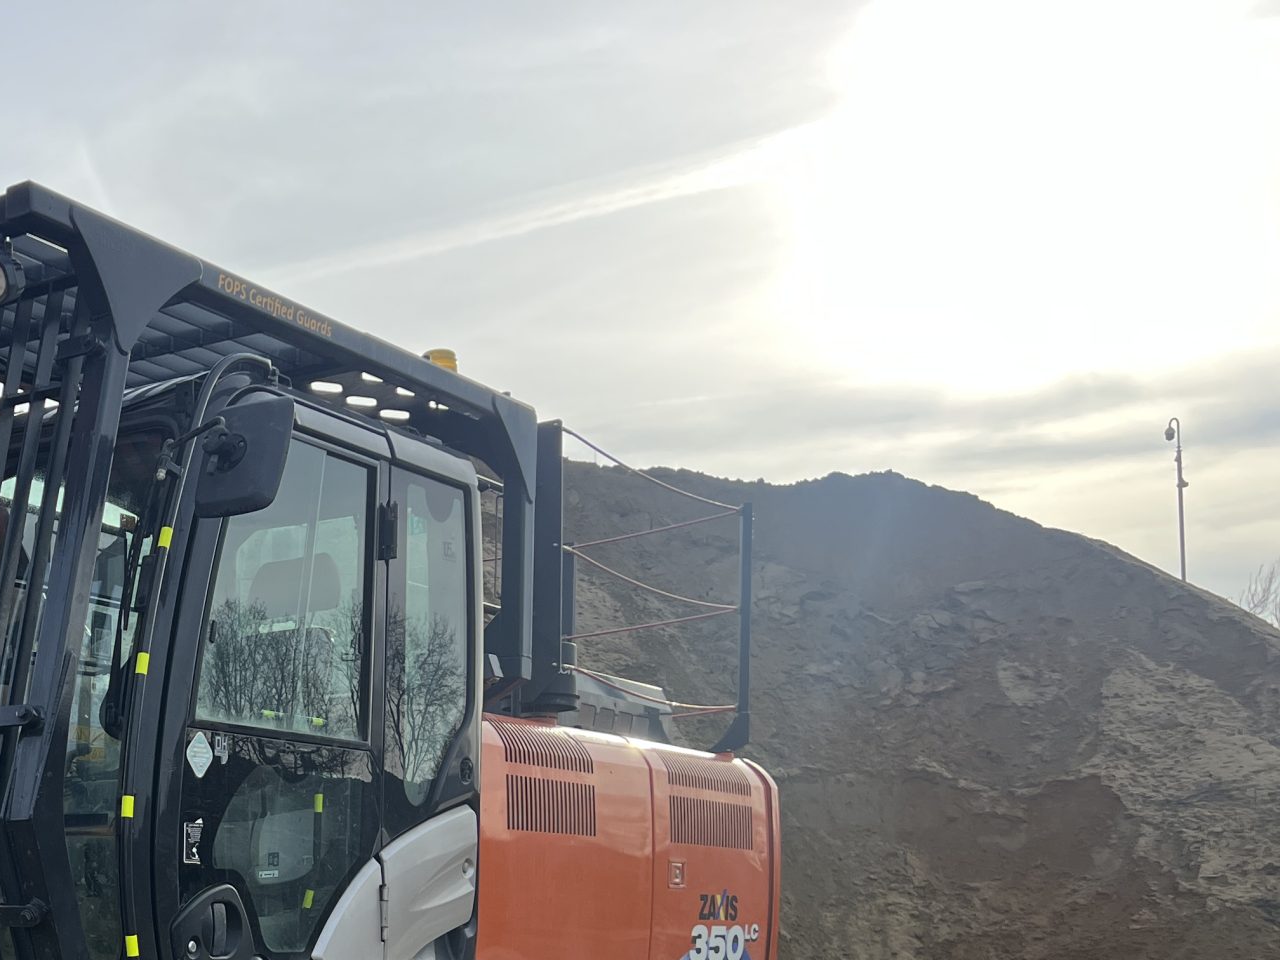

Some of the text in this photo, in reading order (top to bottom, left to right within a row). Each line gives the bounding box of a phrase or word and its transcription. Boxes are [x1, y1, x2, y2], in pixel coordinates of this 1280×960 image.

[218, 272, 333, 337] FOPS Certified Guards
[699, 889, 738, 921] ZAXIS
